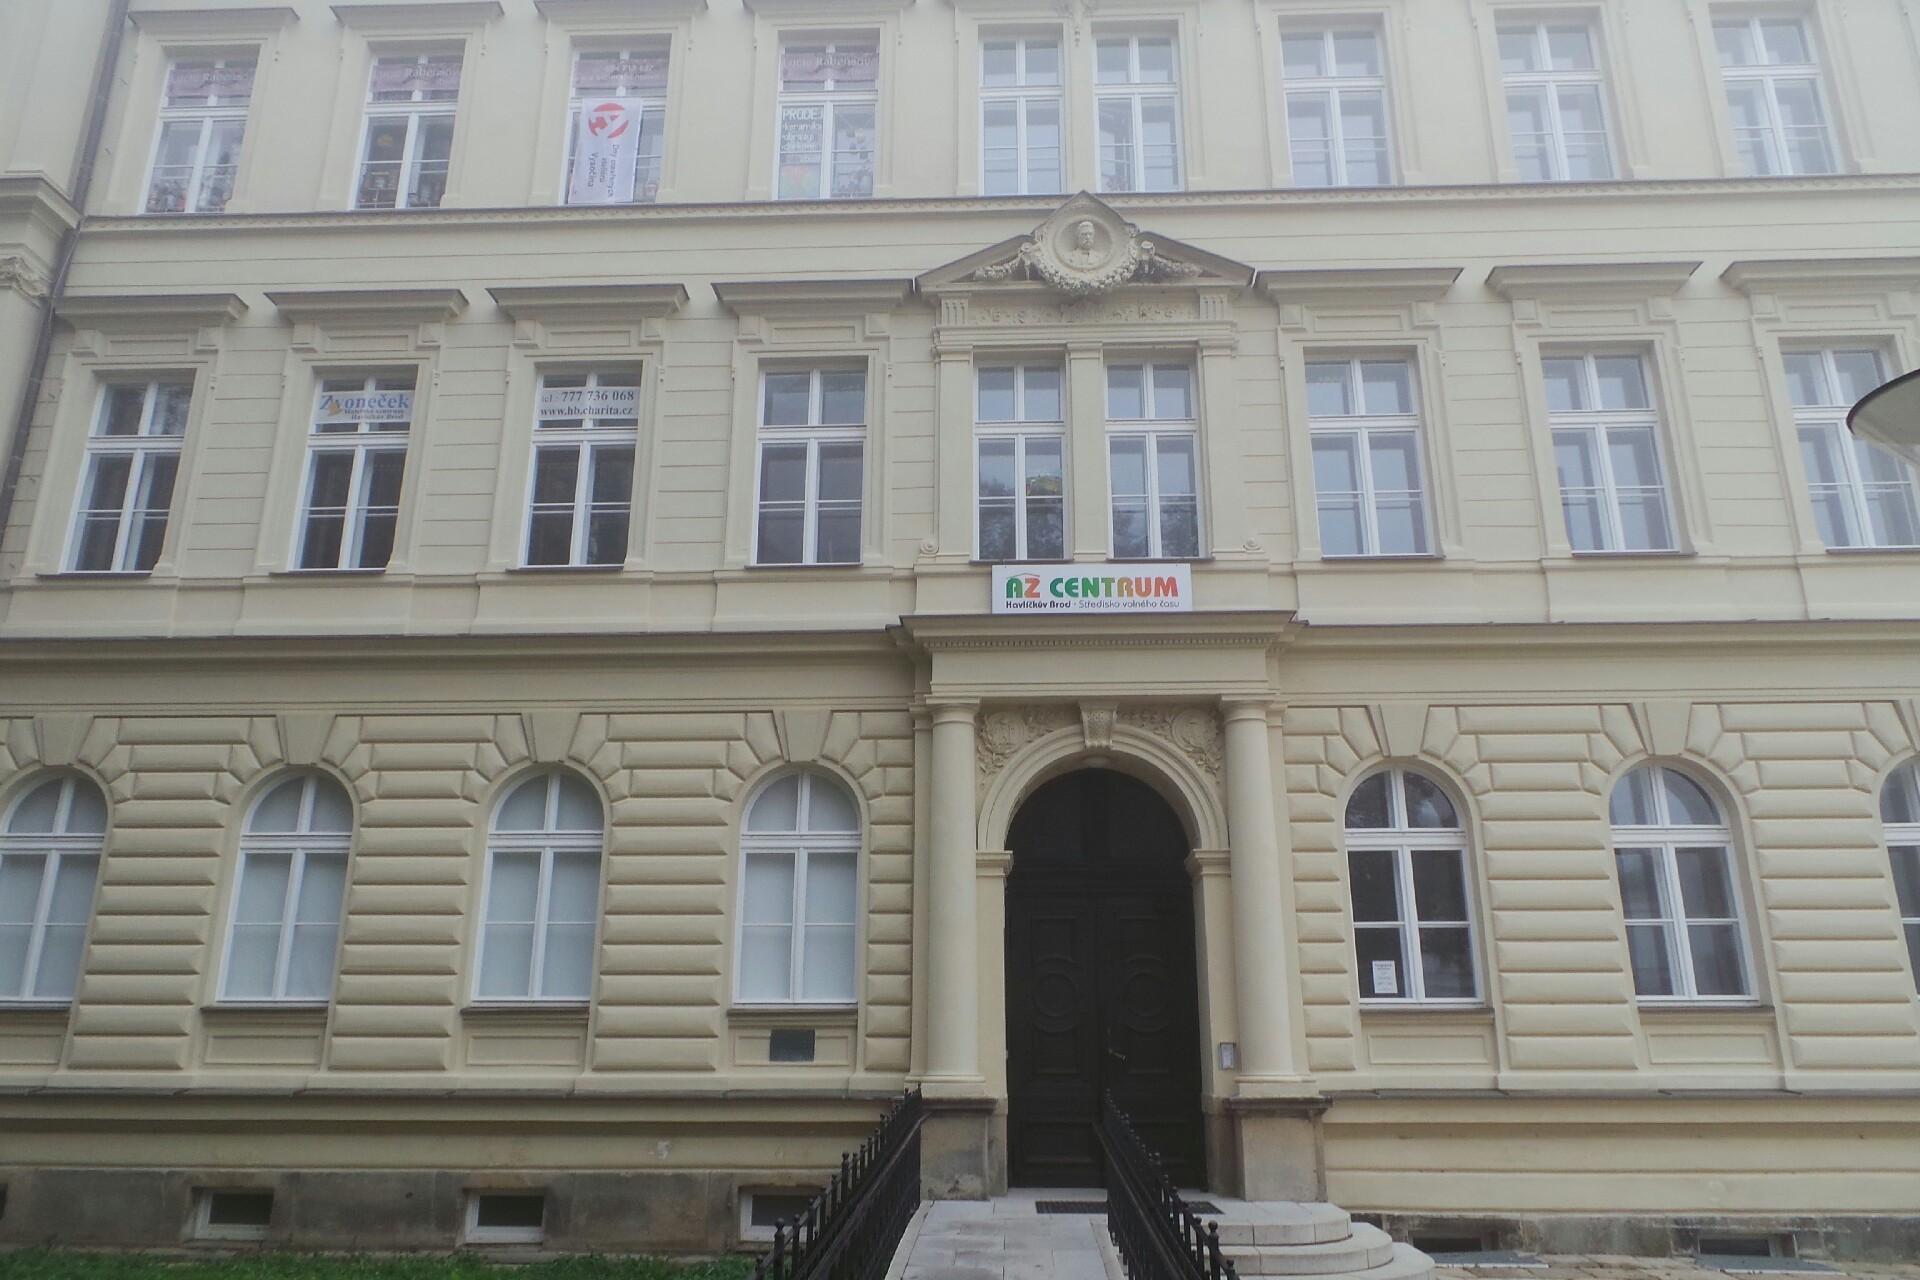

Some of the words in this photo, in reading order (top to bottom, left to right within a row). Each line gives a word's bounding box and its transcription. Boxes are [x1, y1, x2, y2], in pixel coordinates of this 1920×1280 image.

[782, 108, 824, 121] PRODEJ
[609, 144, 620, 158] Dny
[587, 152, 599, 189] Vysočina
[562, 391, 583, 402] 777
[587, 390, 608, 401] 736
[612, 390, 634, 401] 068
[540, 405, 633, 416] www.hb.charita.cz
[1006, 577, 1041, 598] AZ
[1049, 576, 1179, 598] CENTRUM
[1006, 599, 1048, 609] Havlíčkův
[1049, 599, 1071, 609] Brod
[1078, 599, 1120, 609] Středisko
[1123, 599, 1157, 608] volného
[1159, 600, 1180, 608] času
